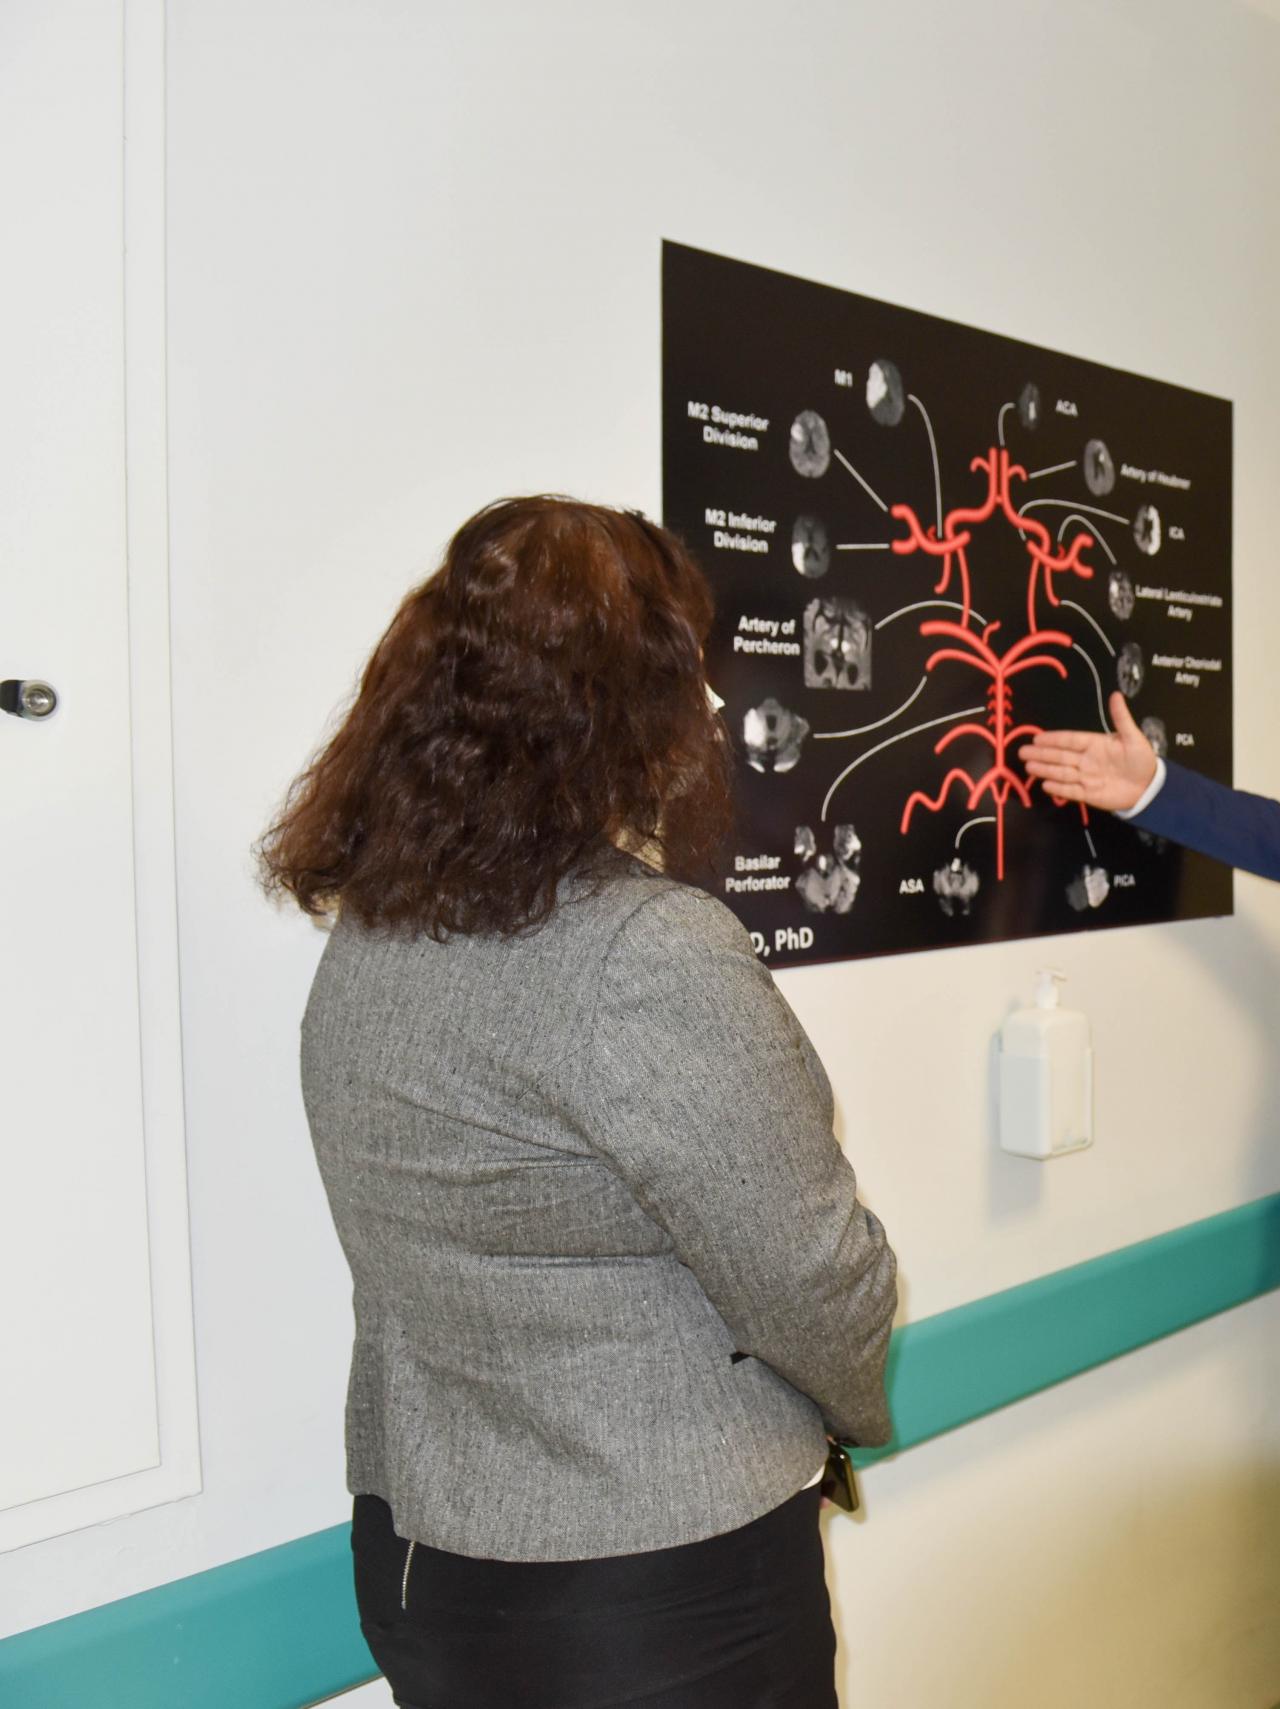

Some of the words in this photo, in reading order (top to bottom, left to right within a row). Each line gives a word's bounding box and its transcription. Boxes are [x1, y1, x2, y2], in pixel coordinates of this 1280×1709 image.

[834, 369, 852, 386] M1
[688, 401, 709, 420] M2
[710, 406, 769, 432] Superior
[1056, 400, 1078, 416] ACA
[703, 425, 759, 450] Division
[705, 508, 726, 527] M2
[728, 512, 776, 533] Inferior
[1169, 526, 1185, 540] ICA
[714, 531, 769, 553] Division
[1168, 605, 1192, 622] Artery
[738, 615, 779, 637] Artery
[781, 619, 795, 635] of
[734, 636, 800, 655] Percheron
[1175, 672, 1200, 687] Artery
[1176, 733, 1194, 746] PCA
[735, 855, 781, 871] Basilar
[725, 876, 791, 892] Perforator
[899, 879, 924, 894] ASA
[1114, 874, 1135, 887] PICA
[749, 930, 771, 958] D,
[775, 927, 813, 951] PhD
